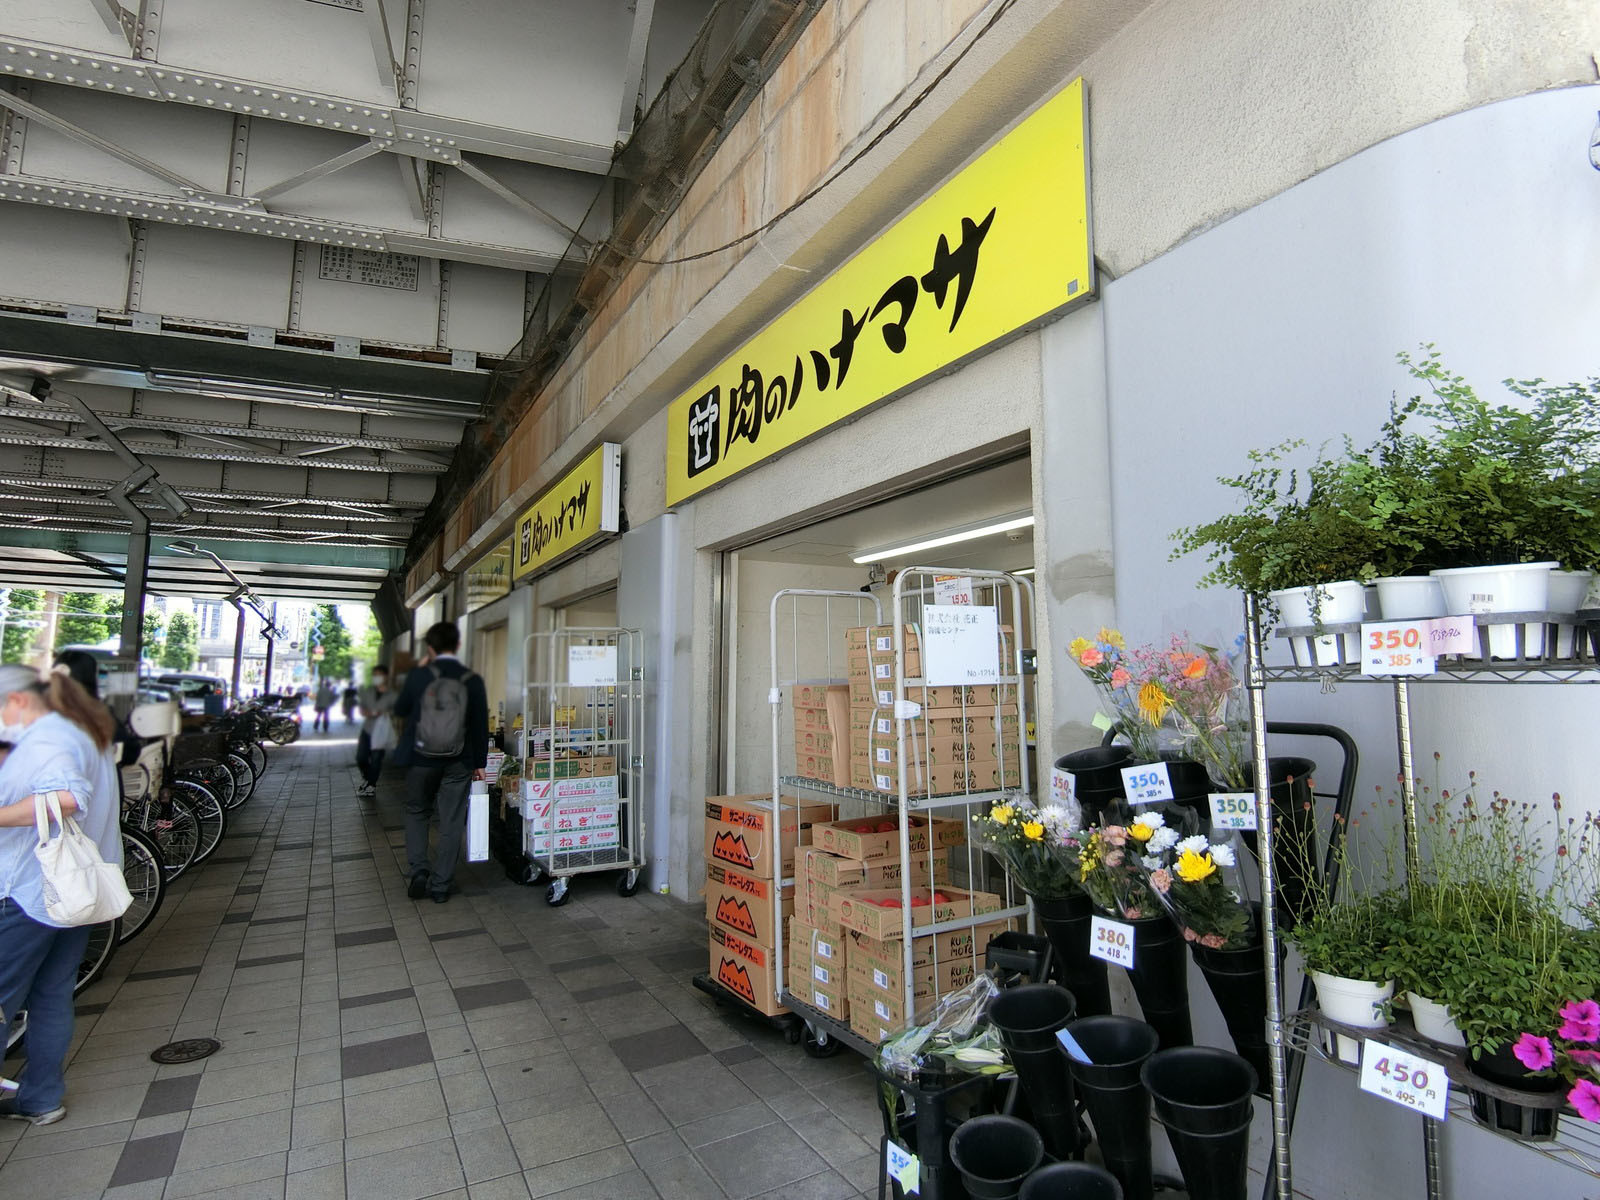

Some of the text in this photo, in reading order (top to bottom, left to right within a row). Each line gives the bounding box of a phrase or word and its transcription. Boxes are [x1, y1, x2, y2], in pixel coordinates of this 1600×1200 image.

[723, 207, 996, 461] 肉のハナマサ
[531, 479, 591, 560] 肉のハナマサ
[558, 815, 592, 829] ねぎ
[729, 808, 757, 829] サニーレタス
[559, 834, 592, 847] ねぎ
[728, 872, 755, 894] サニーレタス
[727, 935, 754, 961] サニーレタス
